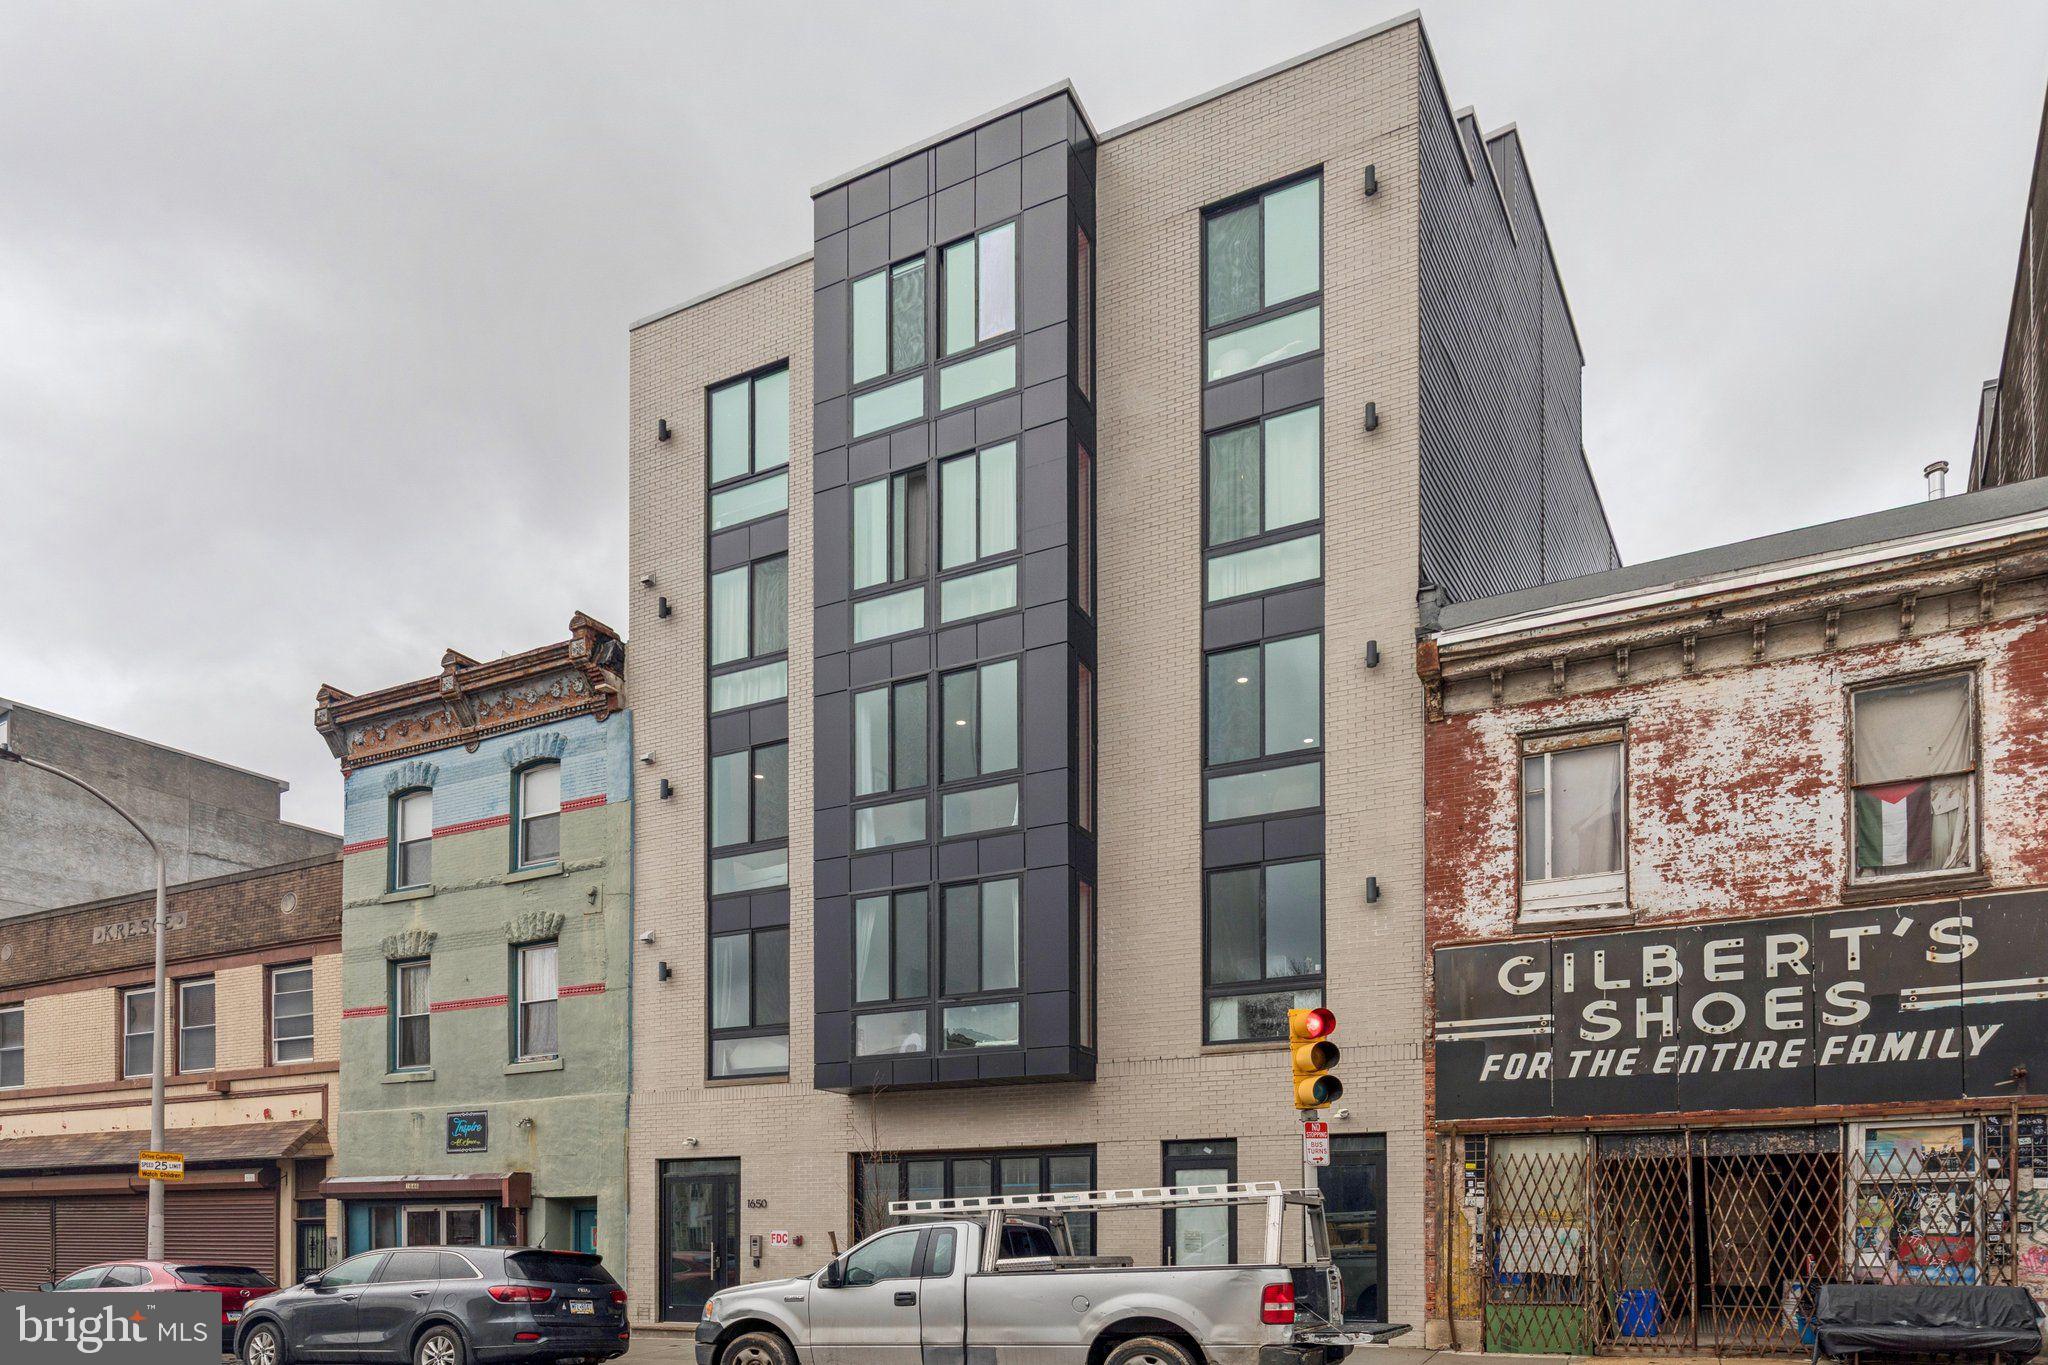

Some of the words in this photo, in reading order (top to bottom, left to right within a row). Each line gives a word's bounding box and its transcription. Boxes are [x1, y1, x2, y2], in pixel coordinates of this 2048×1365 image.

[1498, 916, 1979, 995] GILBERT'S
[1580, 981, 1871, 1041] SHOES
[1480, 1052, 1553, 1081] FOR
[1569, 1047, 1641, 1078] THE
[1652, 1038, 1806, 1074] ENTIRE
[1819, 1023, 2005, 1066] FAMILY
[1311, 1123, 1321, 1131] NO
[154, 1161, 168, 1170] 25
[747, 1199, 767, 1208] 1650
[771, 1233, 788, 1244] FDC
